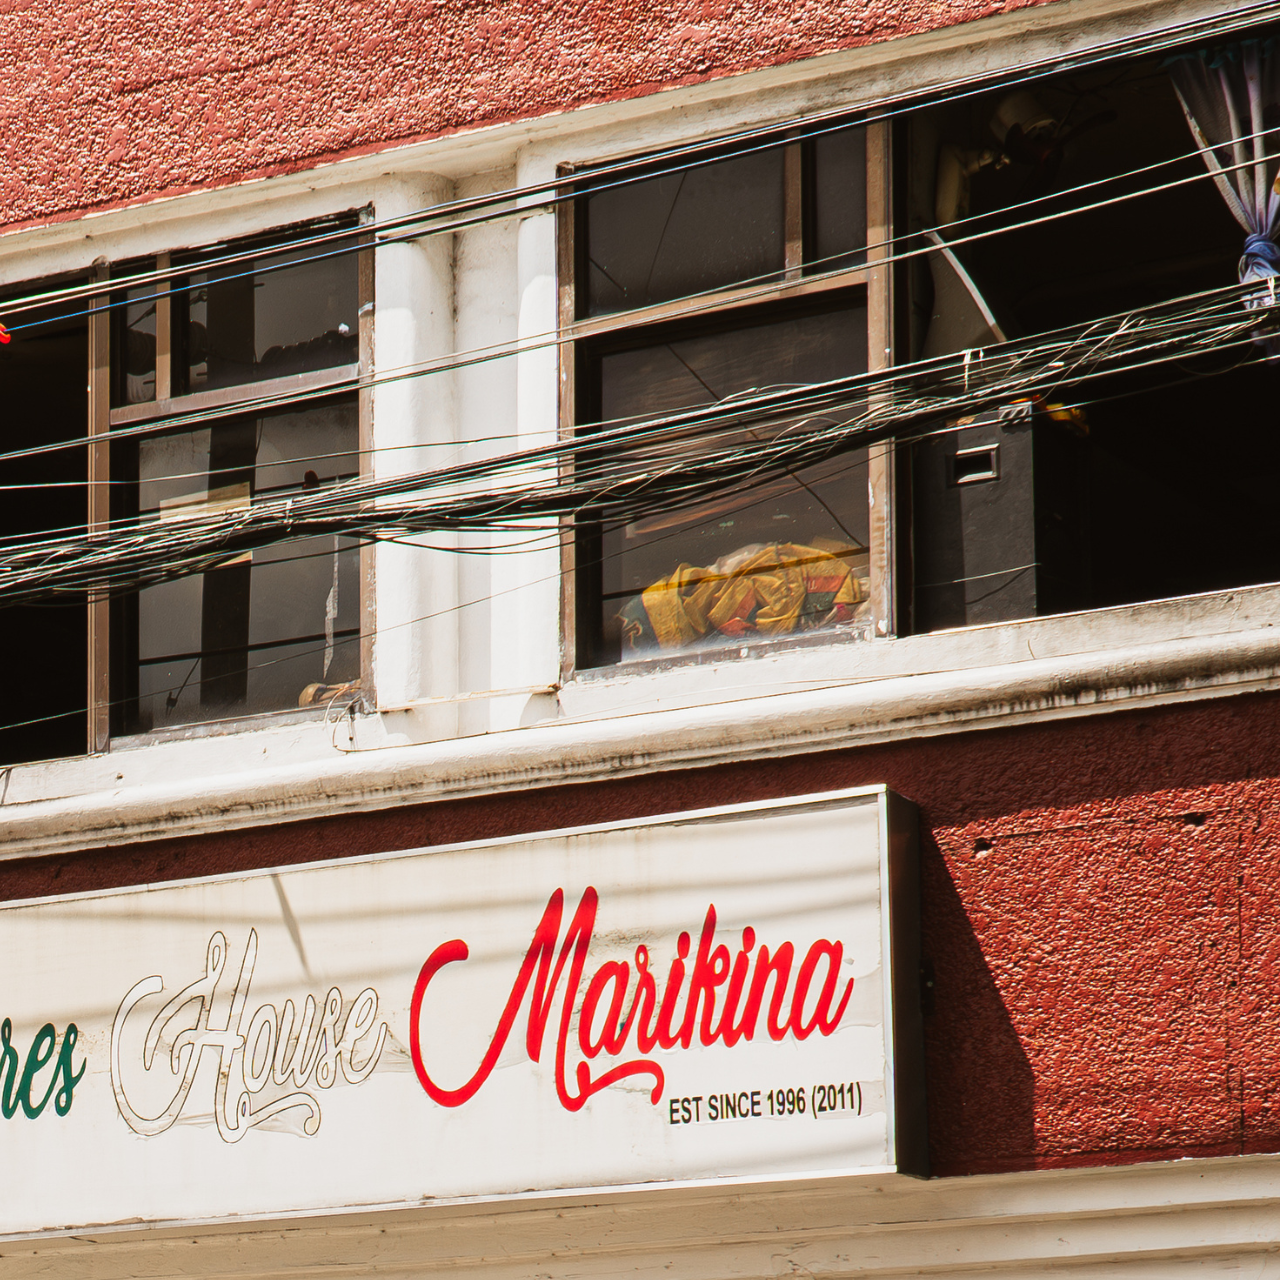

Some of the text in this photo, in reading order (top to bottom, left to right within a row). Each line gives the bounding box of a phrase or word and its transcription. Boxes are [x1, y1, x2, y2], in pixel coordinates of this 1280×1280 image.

[110, 926, 390, 1144] House
[410, 885, 856, 1114] Marikina
[669, 1081, 863, 1126] EST SINCE 1996 (2011)
